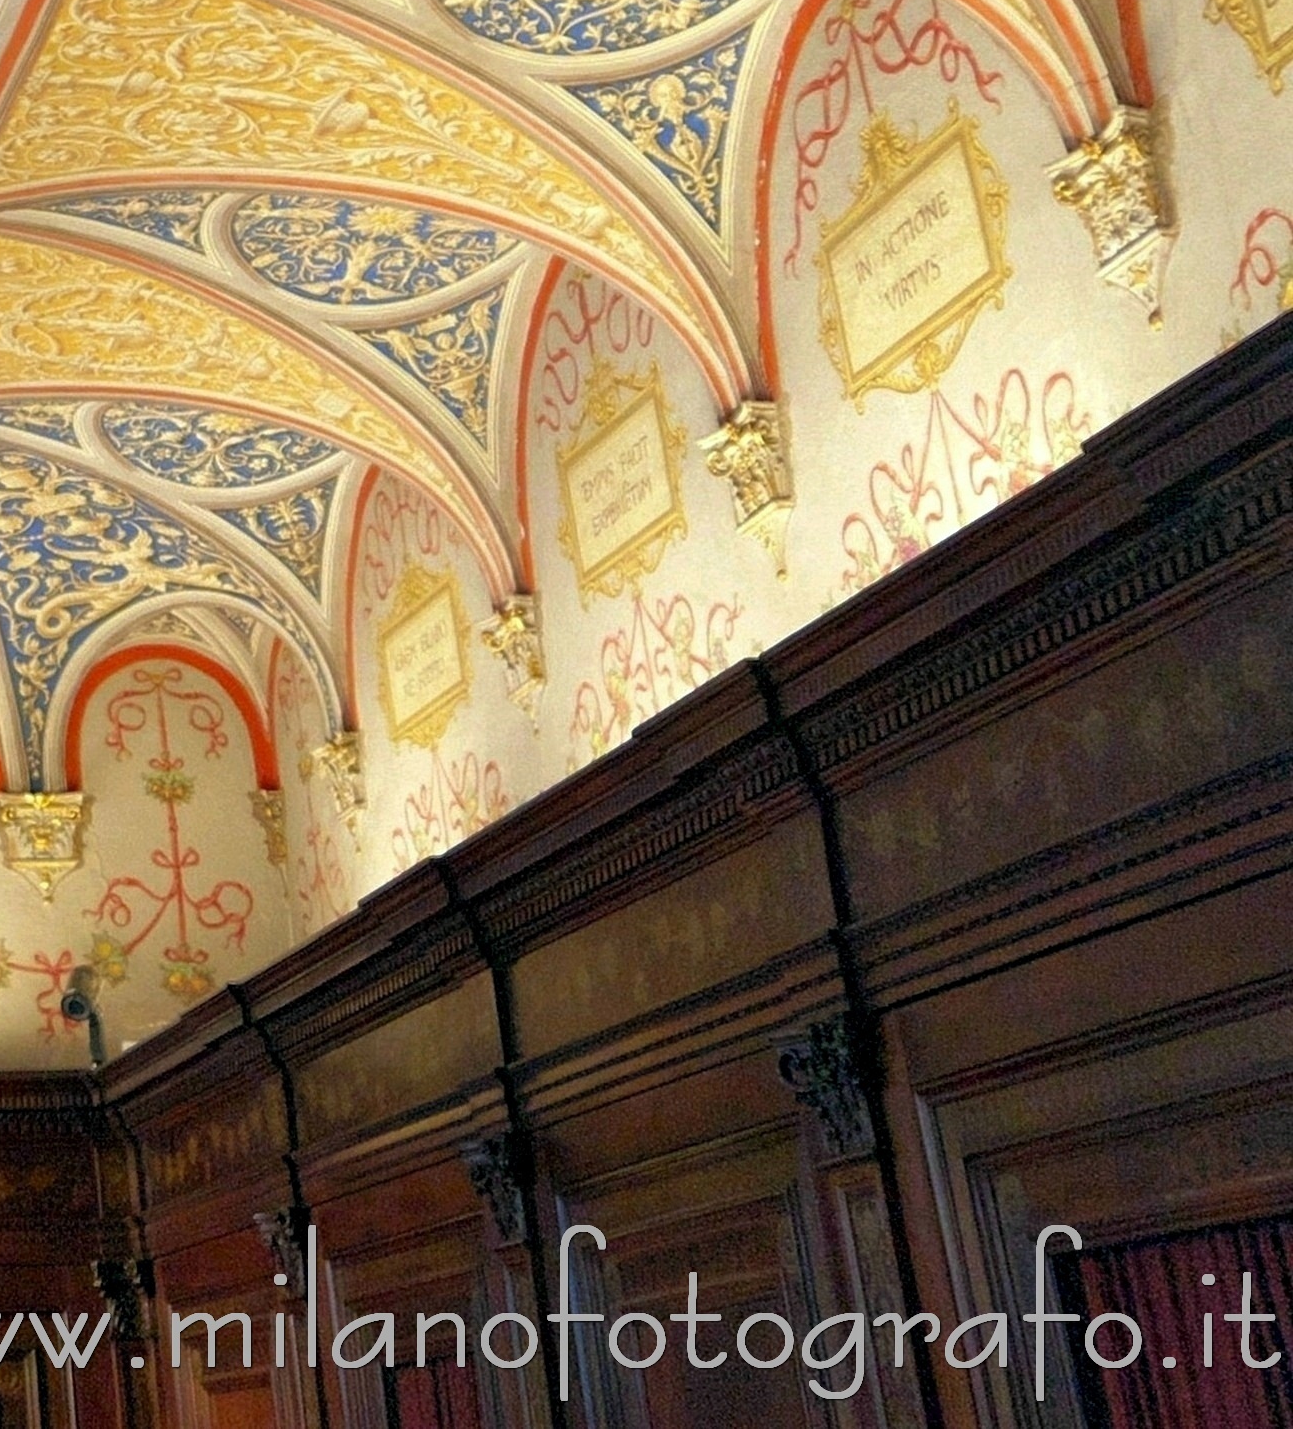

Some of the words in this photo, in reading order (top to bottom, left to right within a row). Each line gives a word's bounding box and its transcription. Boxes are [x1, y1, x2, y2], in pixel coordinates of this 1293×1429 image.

[855, 254, 873, 285] IN
[880, 189, 951, 262] ACTIONE
[882, 254, 943, 311] VIRTVS
